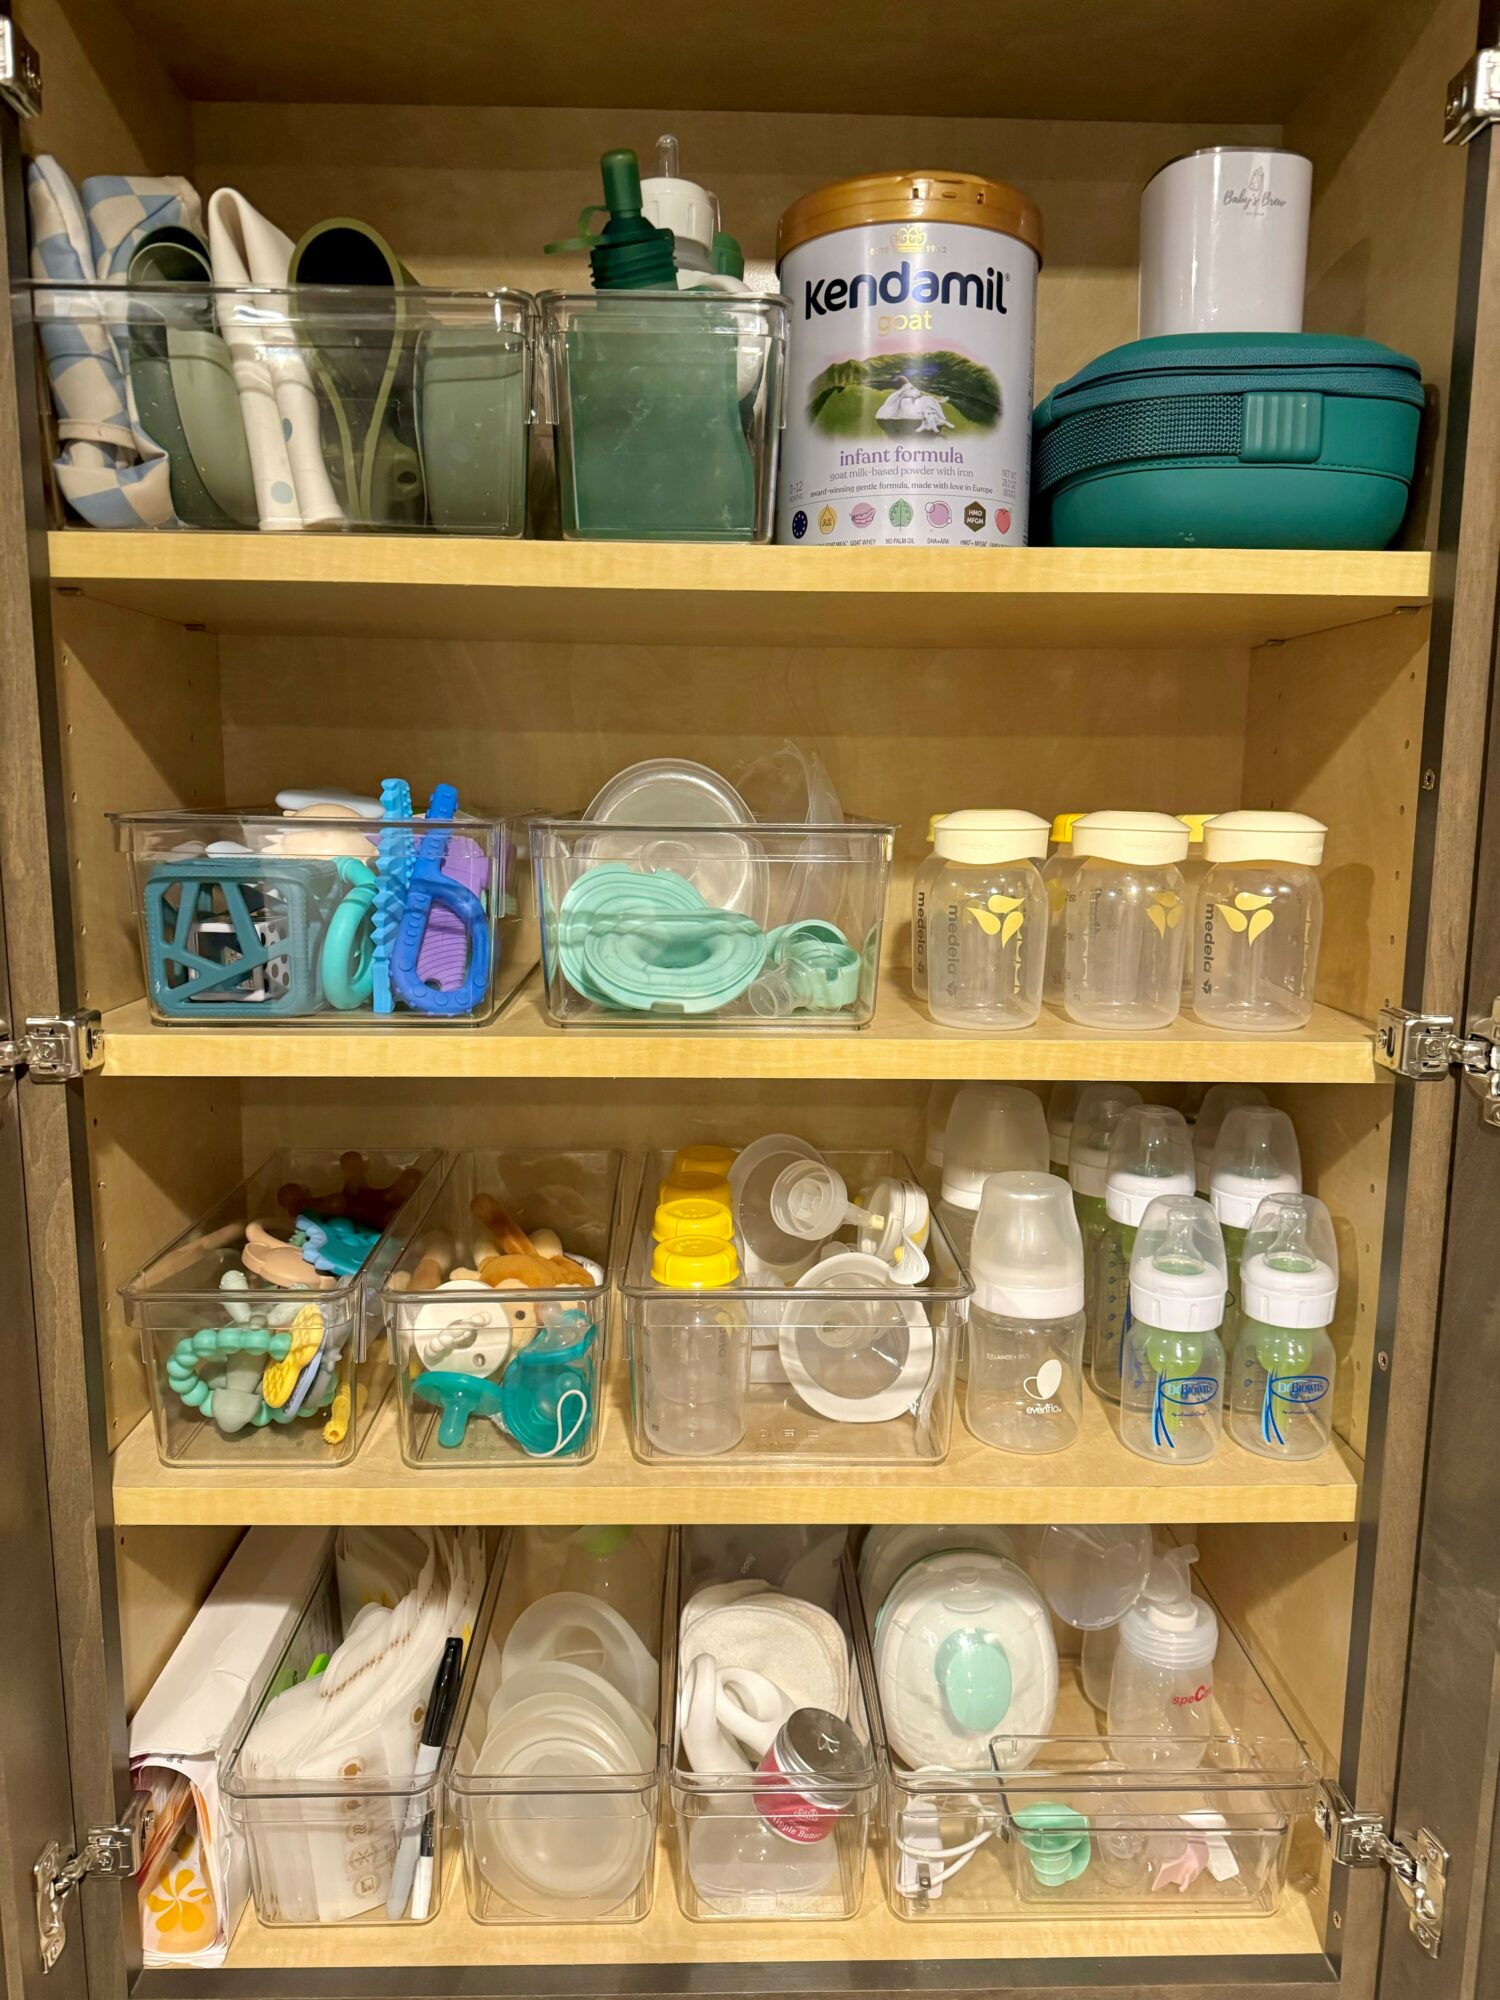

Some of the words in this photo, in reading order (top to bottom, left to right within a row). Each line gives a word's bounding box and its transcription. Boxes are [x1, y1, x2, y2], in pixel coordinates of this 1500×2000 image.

[1223, 188, 1260, 210] Baby's
[1261, 191, 1287, 208] Brew
[805, 261, 1007, 320] Kendamil
[877, 310, 932, 336] goat
[840, 448, 890, 466] infant
[895, 445, 964, 464] formula
[829, 472, 848, 482] goat
[849, 465, 898, 478] milk-based
[900, 466, 935, 478] powder
[936, 467, 955, 477] with
[957, 468, 974, 478] iron
[810, 484, 854, 498] award-winning
[856, 482, 878, 492] gentle
[879, 481, 910, 490] formula,
[911, 481, 932, 489] made
[933, 482, 949, 490] with
[949, 482, 964, 491] love
[965, 483, 971, 491] in
[972, 484, 993, 494] Europe
[966, 517, 984, 526] MFGM
[968, 508, 983, 517] HMO
[849, 539, 862, 547] GOAT
[862, 538, 877, 546] WHEY
[885, 537, 893, 545] NO
[893, 537, 907, 545] PALM
[907, 537, 916, 545] OIL
[917, 891, 926, 954] medela
[947, 904, 960, 975] medela
[1203, 903, 1215, 973] medela
[1026, 1403, 1059, 1415] evenflo
